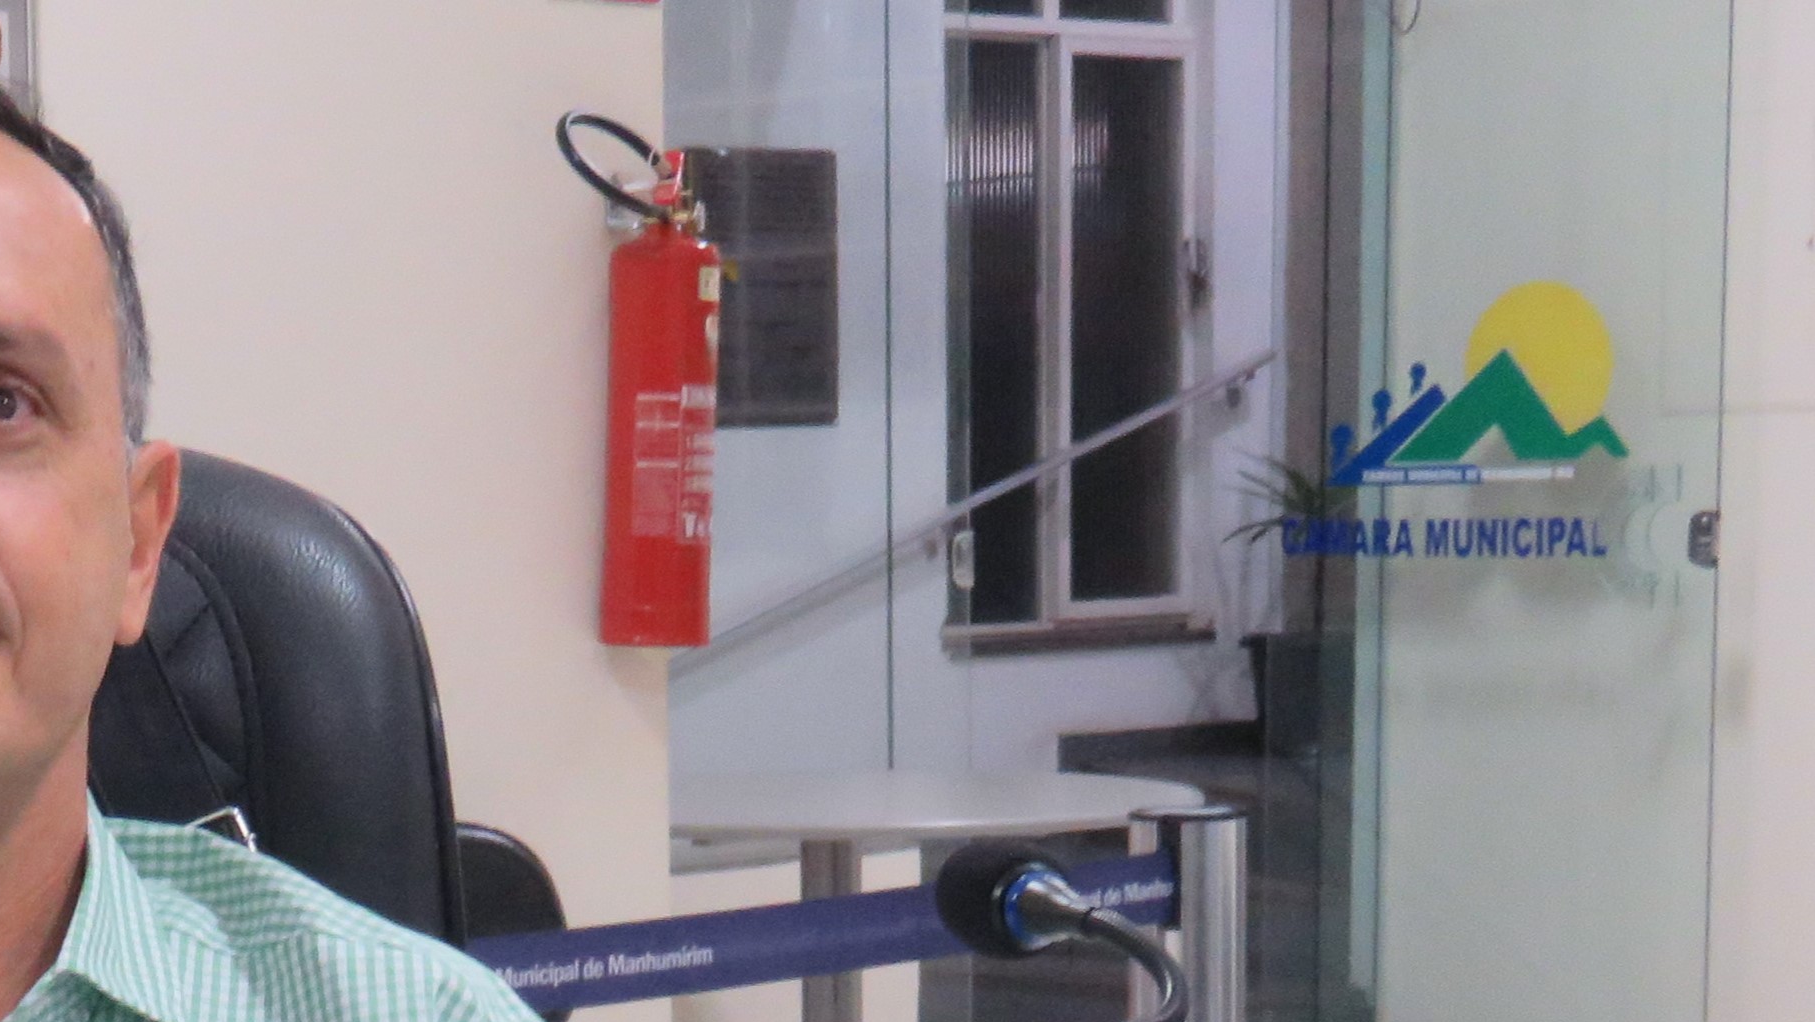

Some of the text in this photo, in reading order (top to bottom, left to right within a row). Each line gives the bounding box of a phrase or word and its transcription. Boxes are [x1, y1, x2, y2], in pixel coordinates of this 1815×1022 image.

[1425, 516, 1608, 558] MUNICIPAL
[496, 945, 714, 987] Municipal de Manhumirim
